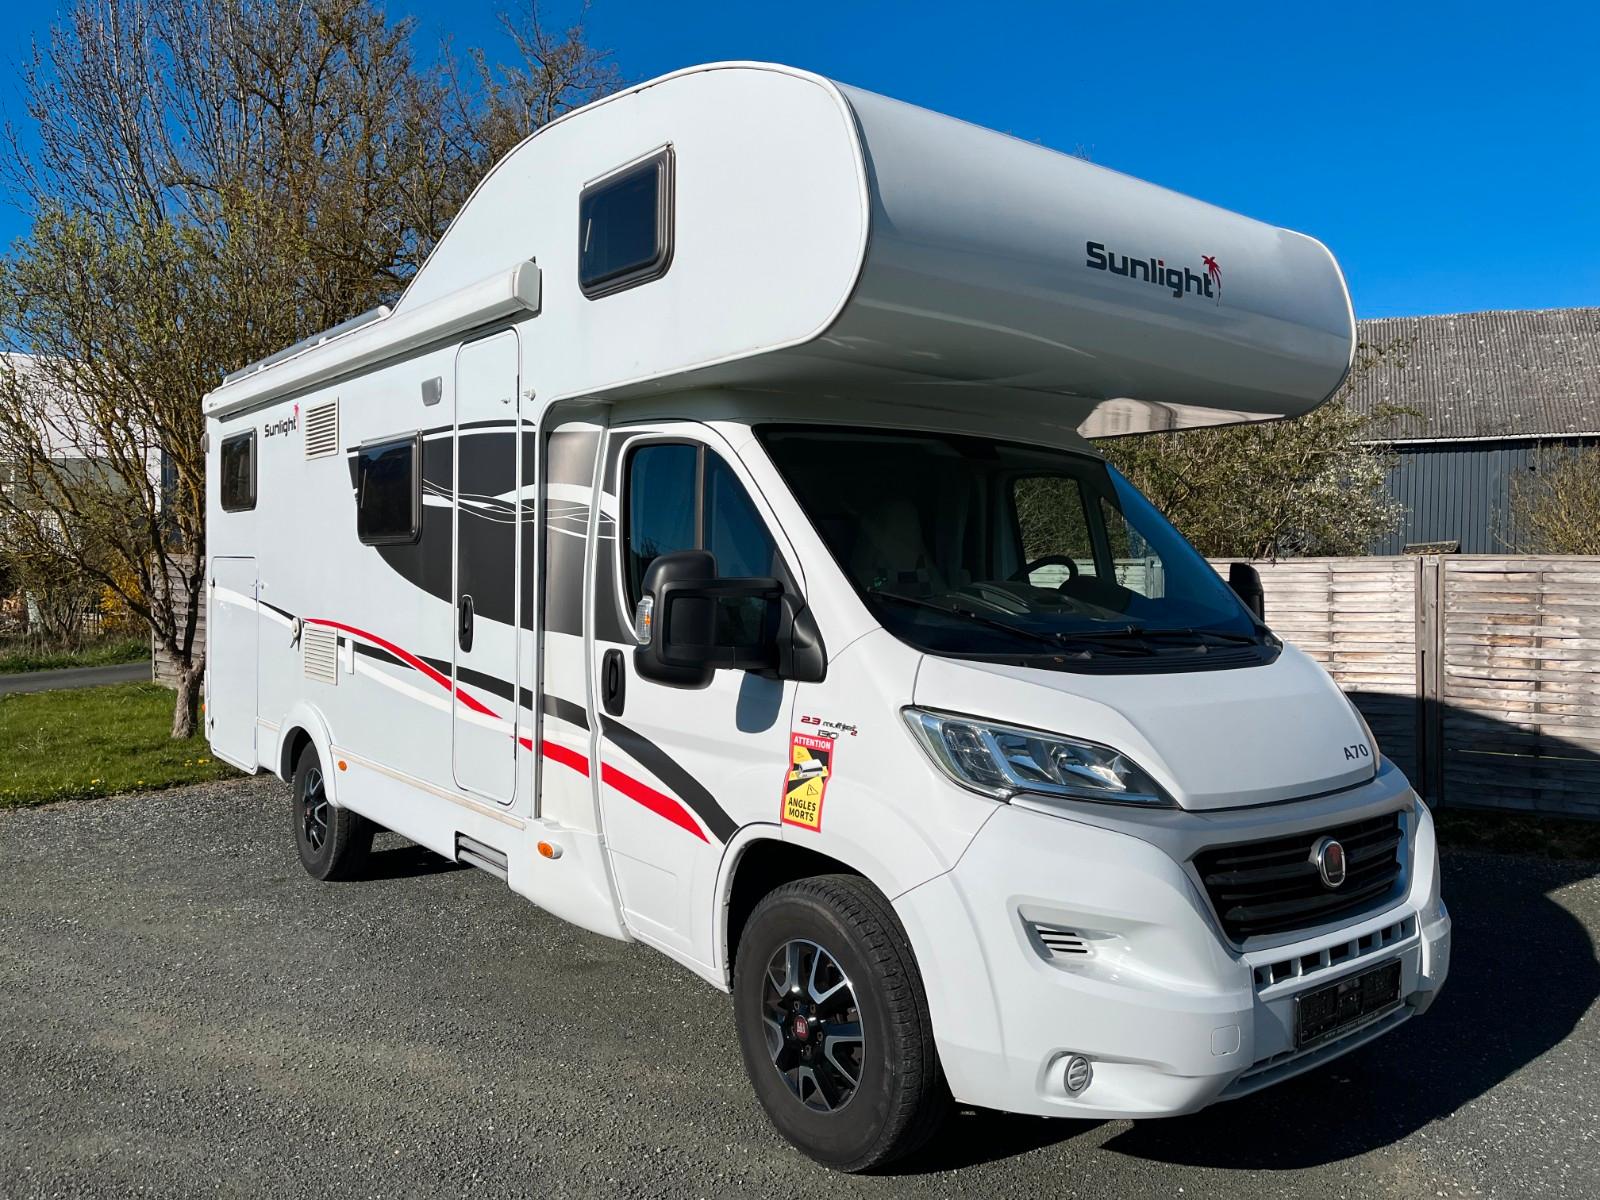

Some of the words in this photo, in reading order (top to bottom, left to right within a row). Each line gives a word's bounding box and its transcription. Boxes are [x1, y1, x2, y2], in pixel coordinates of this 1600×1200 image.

[1086, 241, 1214, 299] Sunlight
[264, 415, 297, 438] Sunlight
[793, 735, 831, 750] ATTENTION
[1343, 743, 1369, 761] A70
[788, 796, 817, 812] ANGLES
[788, 807, 814, 822] MORTS
